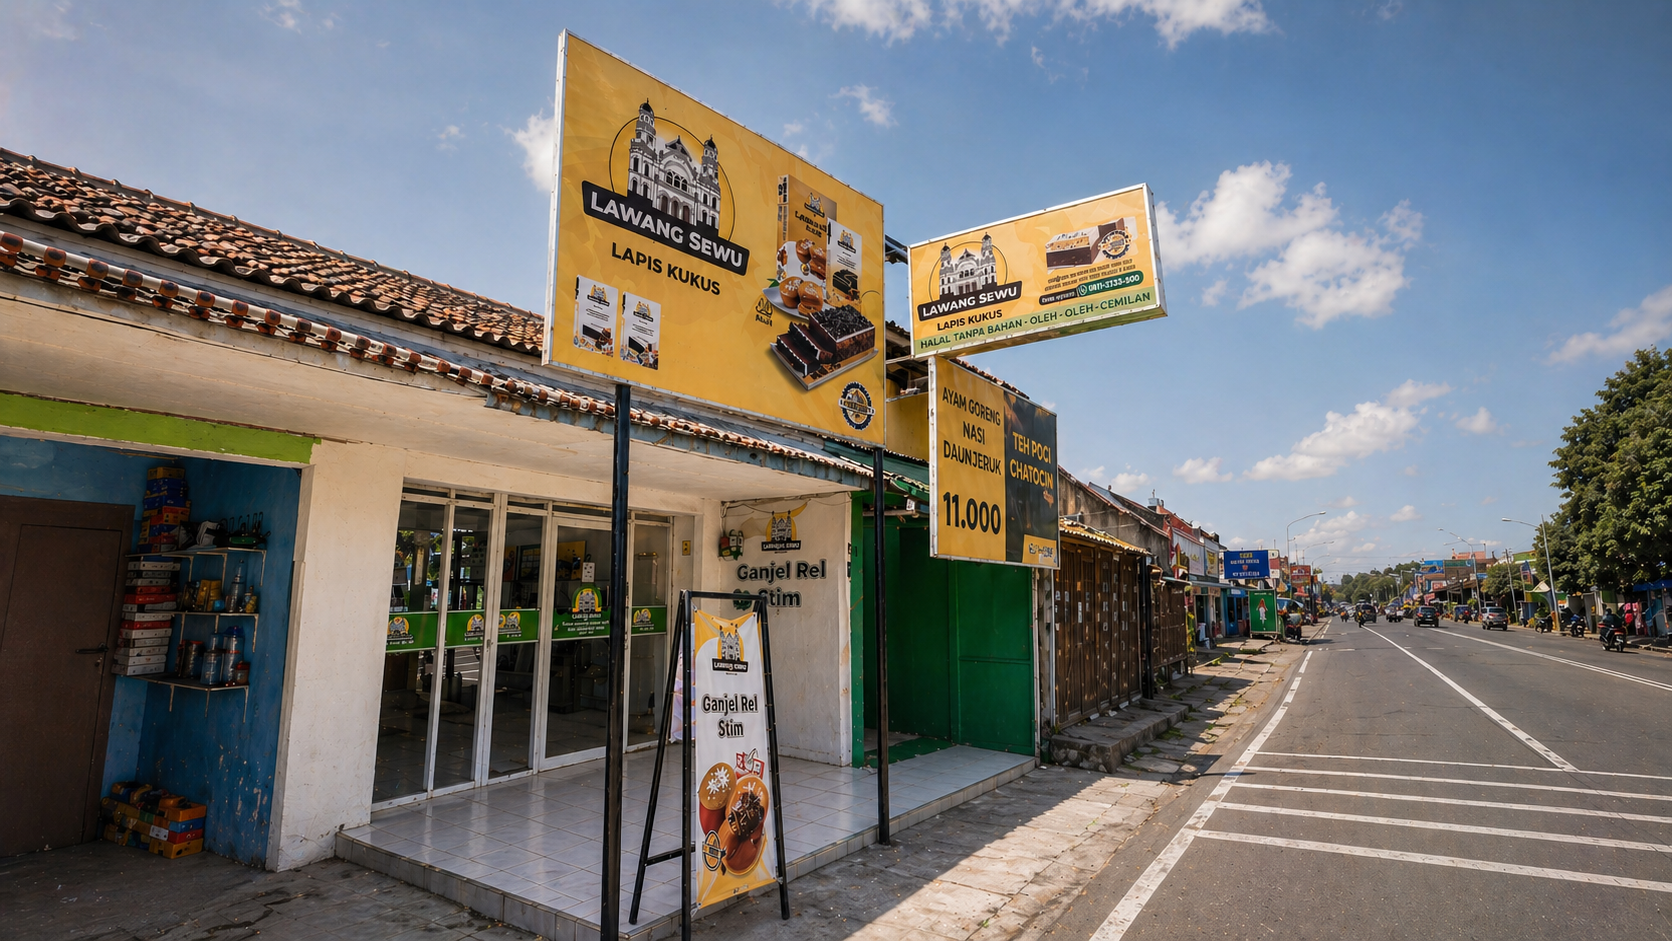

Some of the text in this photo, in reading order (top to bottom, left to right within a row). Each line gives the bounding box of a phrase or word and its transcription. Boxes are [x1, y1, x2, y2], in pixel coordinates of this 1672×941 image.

[590, 191, 743, 268] LAWANG SEWU
[611, 242, 721, 295] LAPIS KUKUS
[922, 296, 976, 317] LAWANG
[979, 286, 1018, 304] SEWU
[920, 335, 951, 349] HALAL
[953, 327, 986, 341] TANPA
[987, 319, 1023, 334] BAHAN
[1029, 311, 1057, 325] OLEH
[1064, 303, 1094, 318] OLEH
[1100, 292, 1151, 310] CEMILAN
[937, 309, 1003, 331] LAPIS KUKUS
[942, 386, 1001, 427] AYAM GORENG
[962, 420, 986, 445] NASI
[1012, 431, 1051, 464] TEH POCI
[943, 439, 1002, 476] DAUNJERUK
[942, 491, 1001, 535] 11.000
[737, 560, 827, 584] Ganjel Rel
[702, 694, 759, 716] Ganjel Rel
[718, 719, 744, 737] Stim
